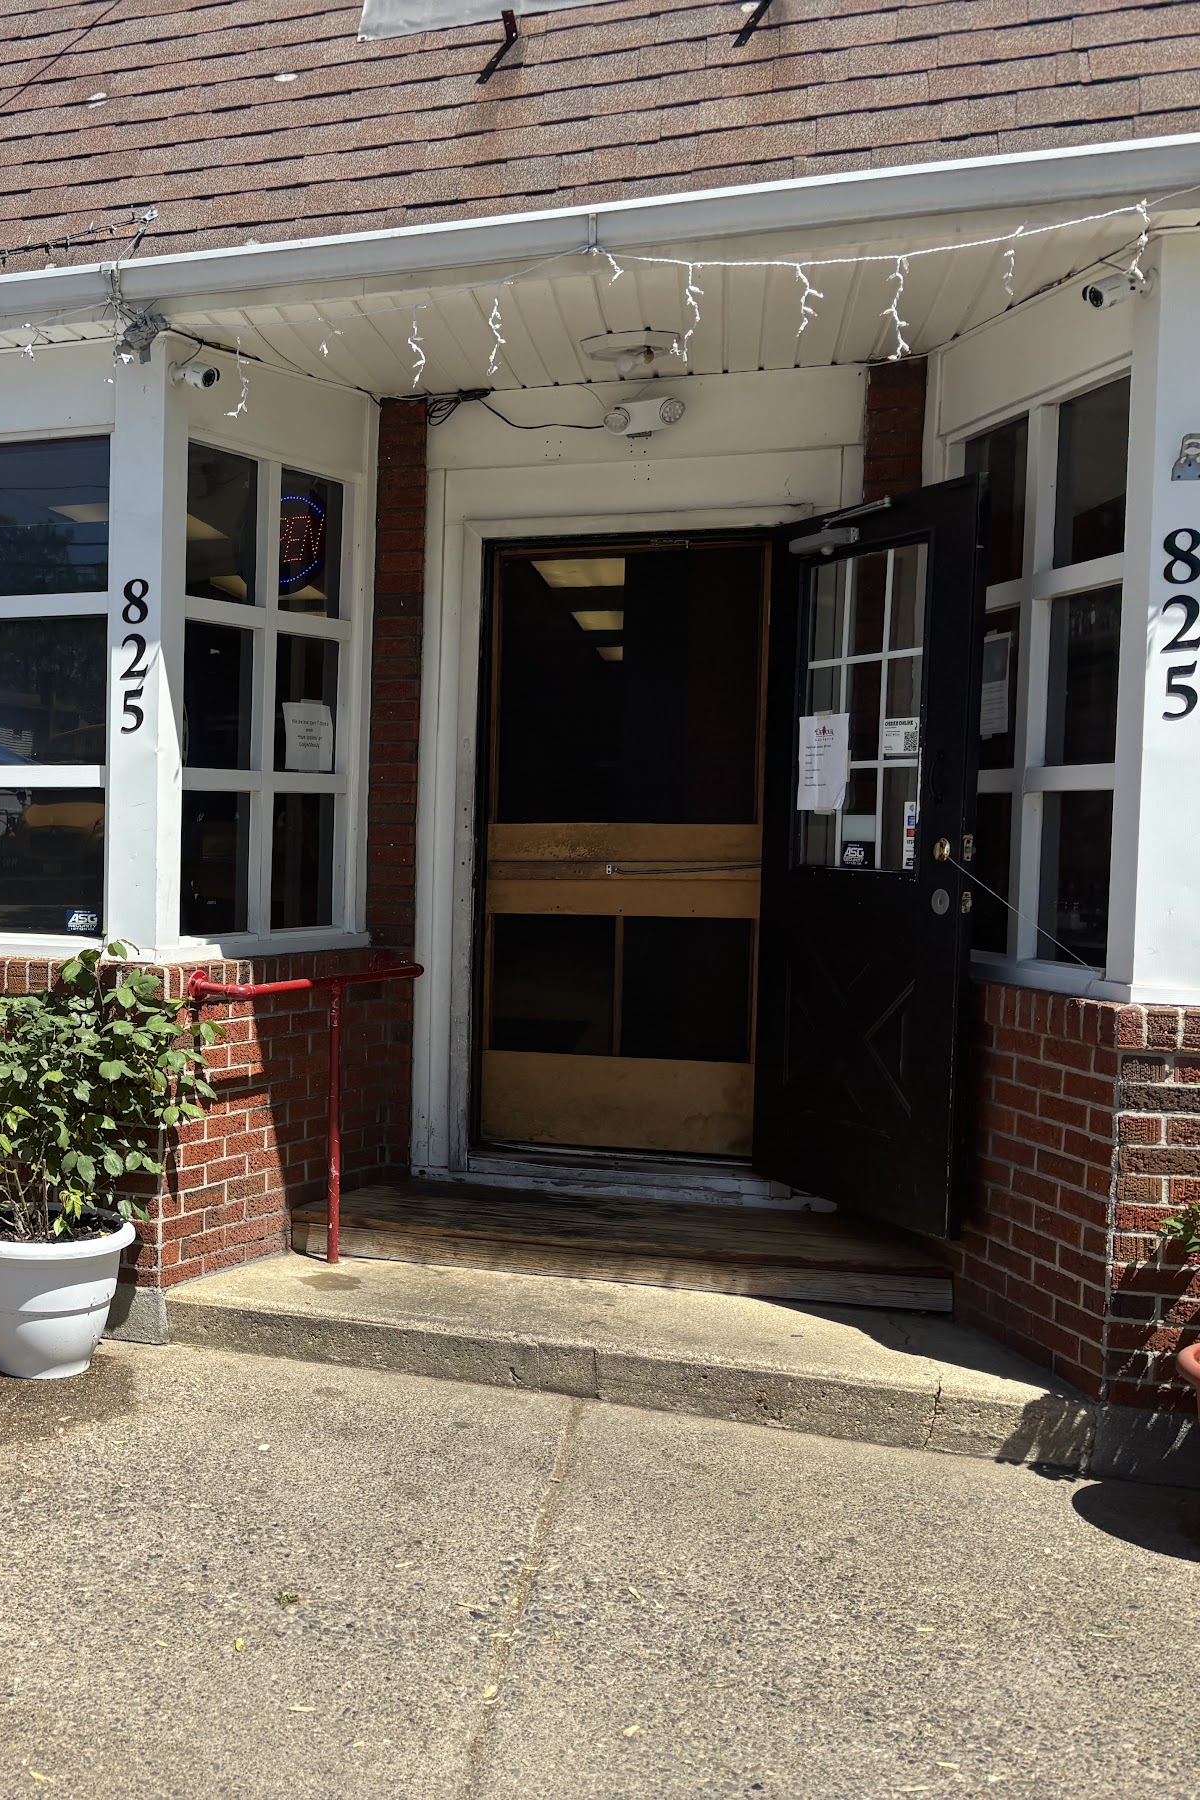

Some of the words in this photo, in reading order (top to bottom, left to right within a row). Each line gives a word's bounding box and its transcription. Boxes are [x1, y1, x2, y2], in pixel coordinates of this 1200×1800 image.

[119, 578, 150, 735] 825
[1160, 528, 1200, 722] 825
[843, 847, 865, 857] ASG
[68, 913, 98, 922] ASG
